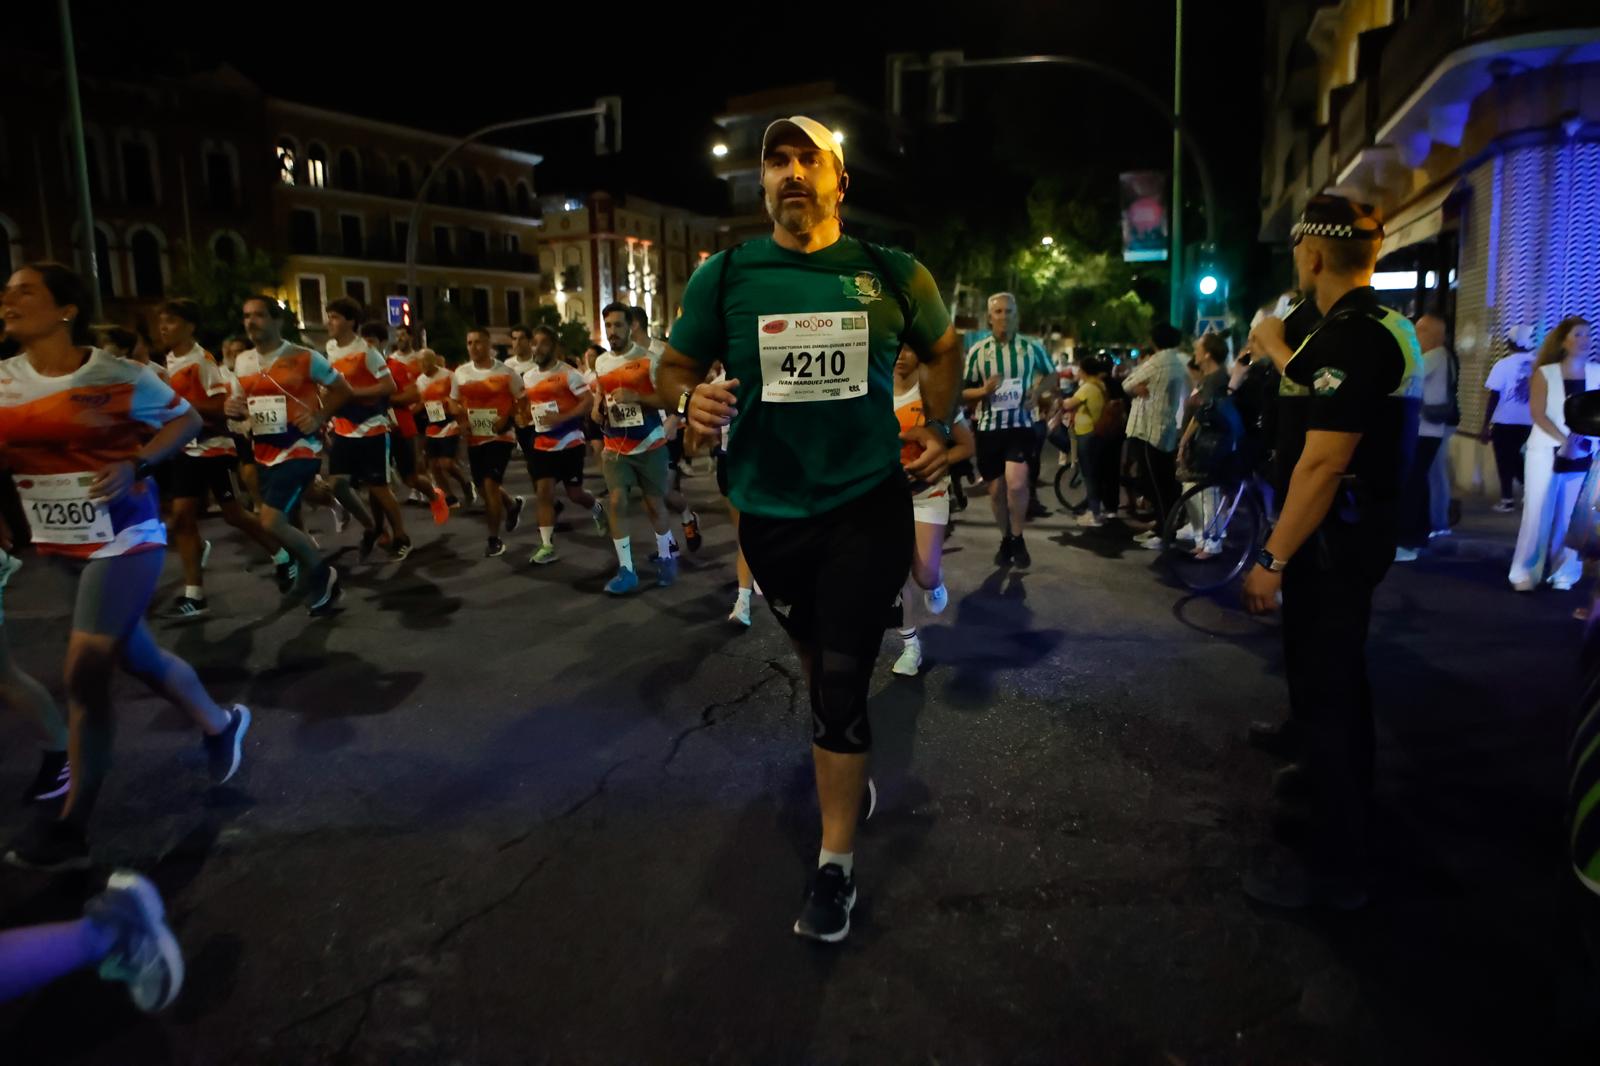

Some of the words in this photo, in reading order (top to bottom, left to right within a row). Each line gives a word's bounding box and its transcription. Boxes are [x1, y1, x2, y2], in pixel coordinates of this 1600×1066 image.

[781, 350, 846, 378] 4210
[824, 377, 850, 385] MORENO
[32, 501, 96, 525] 12360
